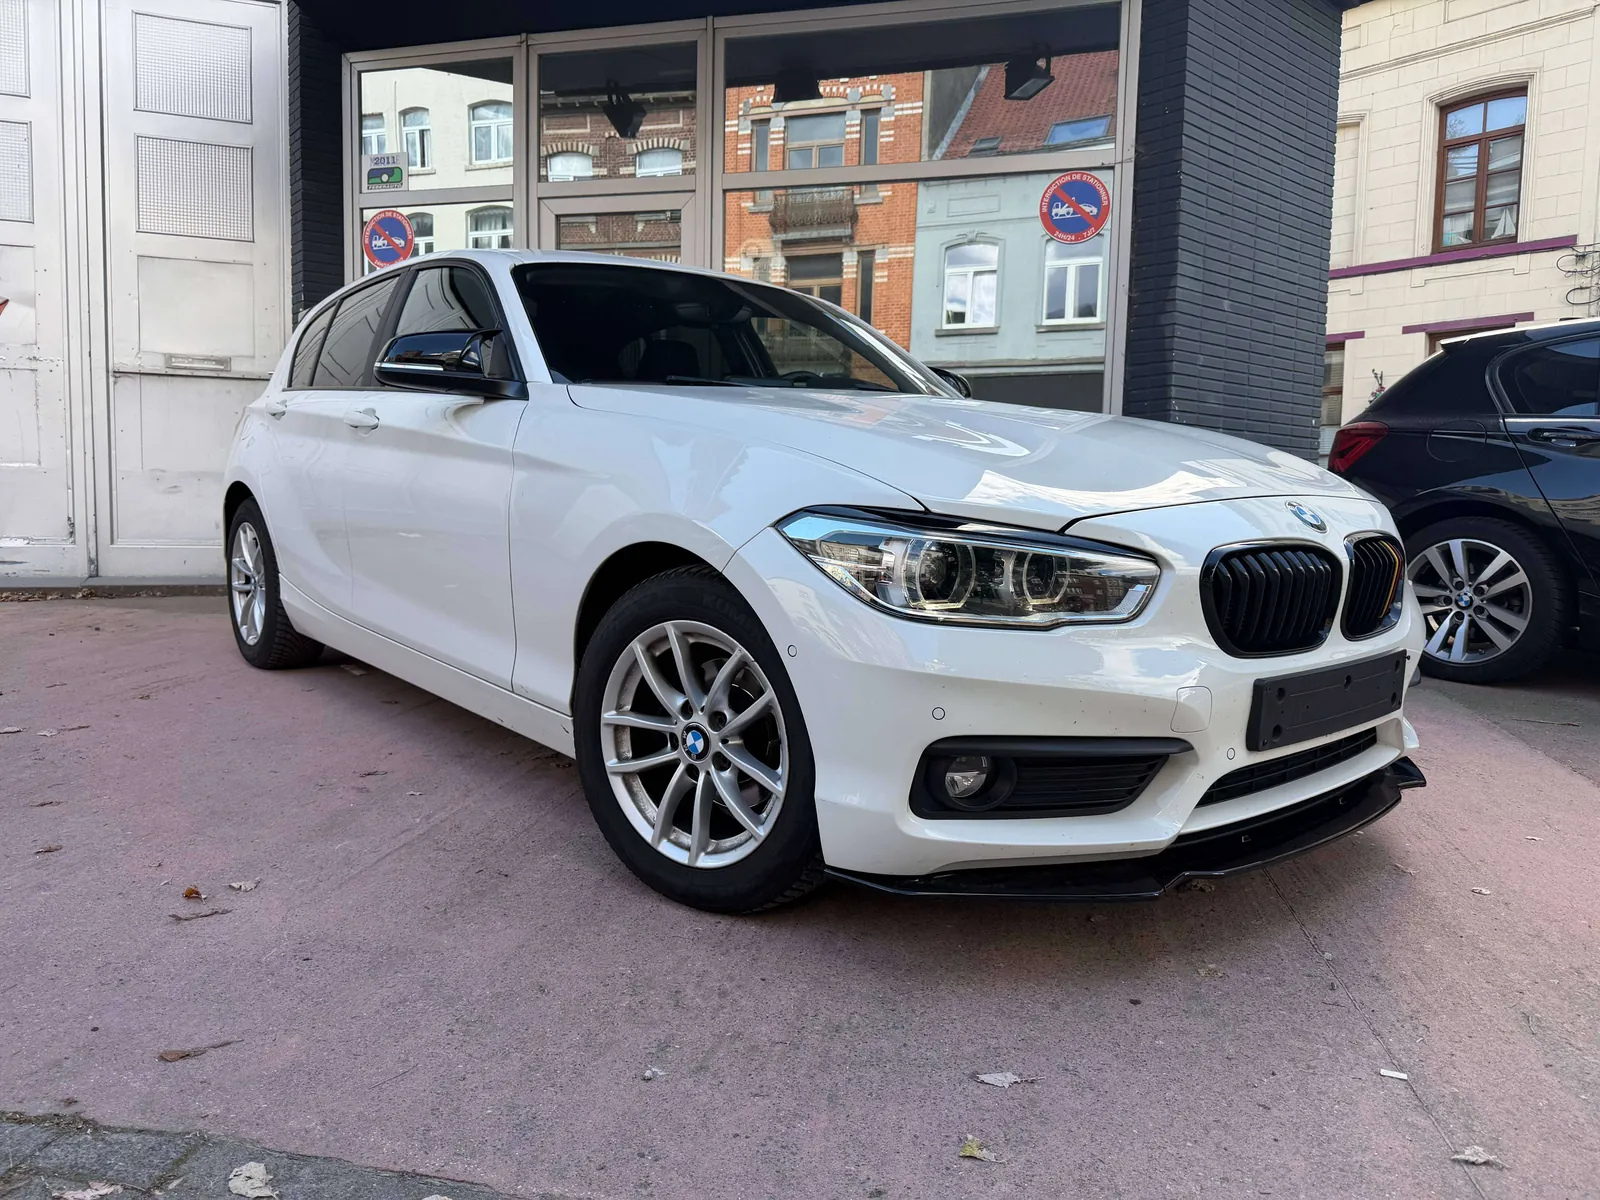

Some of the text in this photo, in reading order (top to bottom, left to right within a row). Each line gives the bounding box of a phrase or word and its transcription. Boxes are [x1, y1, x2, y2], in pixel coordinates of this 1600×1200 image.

[374, 156, 396, 165] 2011
[1041, 173, 1109, 213] INTERDICTION DE STATIONNER
[364, 212, 385, 244] INTERDICTION
[392, 211, 412, 240] STATIONNER
[1054, 231, 1076, 241] 24H/24
